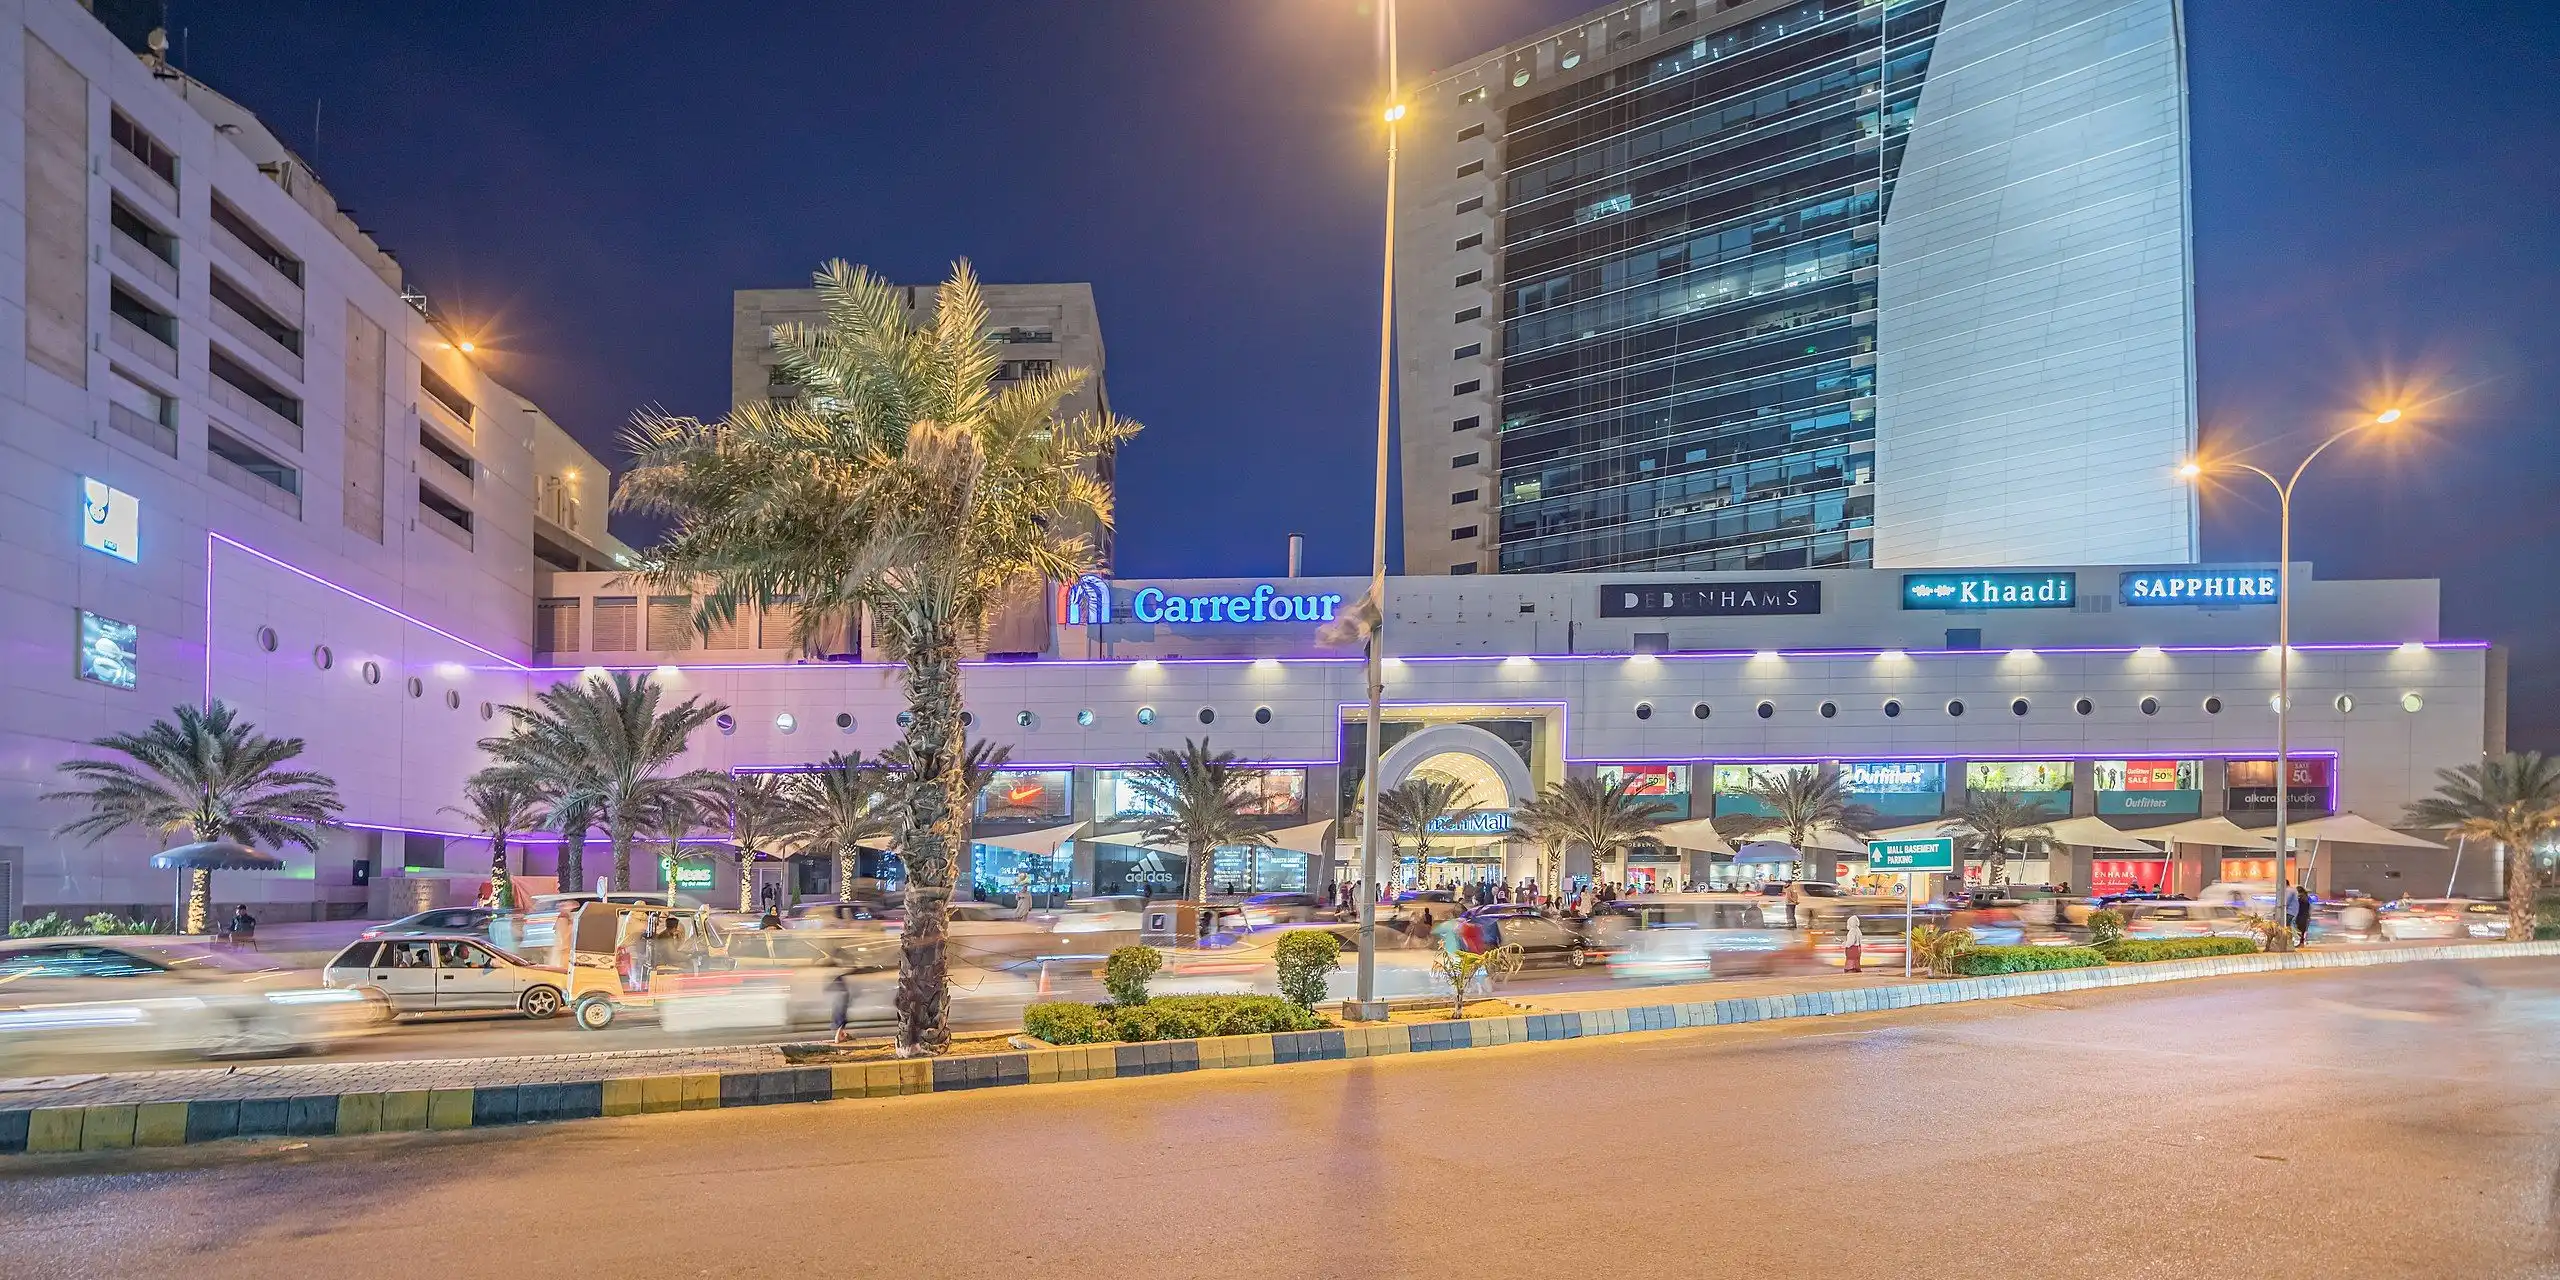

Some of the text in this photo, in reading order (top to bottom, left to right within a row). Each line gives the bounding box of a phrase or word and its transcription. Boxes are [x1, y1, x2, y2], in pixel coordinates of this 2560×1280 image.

[1960, 579, 2068, 603] Khaadi
[2133, 576, 2275, 598] SAPPHIRE
[1134, 584, 1342, 623] Carrefour
[1623, 589, 1799, 609] DEBENHAMS
[2127, 776, 2149, 784] SALE
[2125, 797, 2168, 808] Outfitters
[2244, 792, 2277, 803] alkara
[1886, 844, 1940, 854] MALL BASEMENT
[1887, 855, 1913, 865] PARKING
[1125, 870, 1173, 883] adidas
